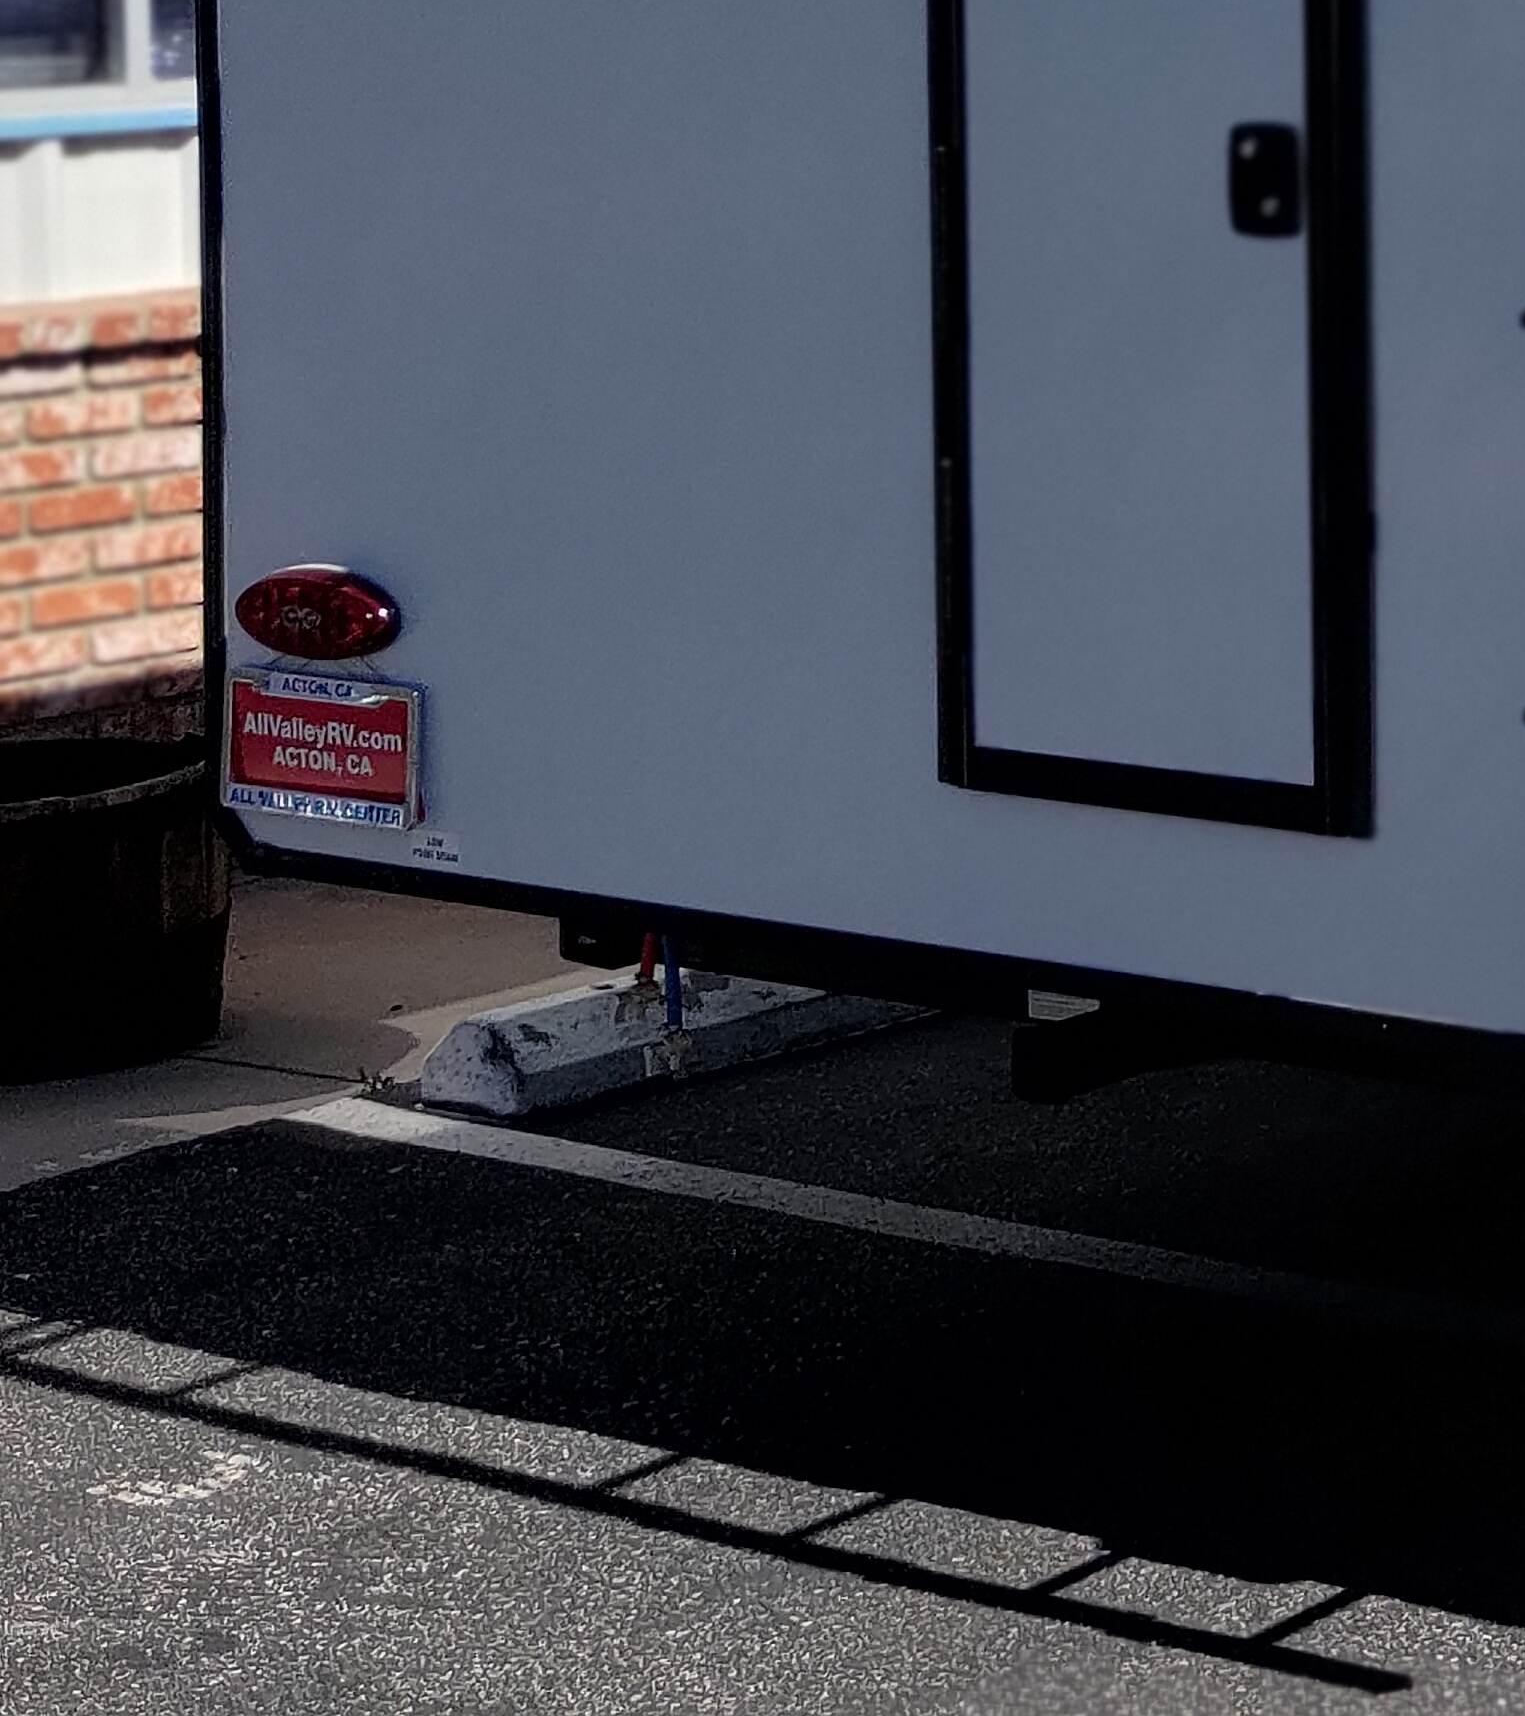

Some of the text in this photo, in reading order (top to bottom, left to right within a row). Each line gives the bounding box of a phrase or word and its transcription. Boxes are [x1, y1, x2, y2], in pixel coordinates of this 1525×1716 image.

[243, 710, 403, 753] AllValleyRV.com
[272, 745, 375, 777] ACTON, CA
